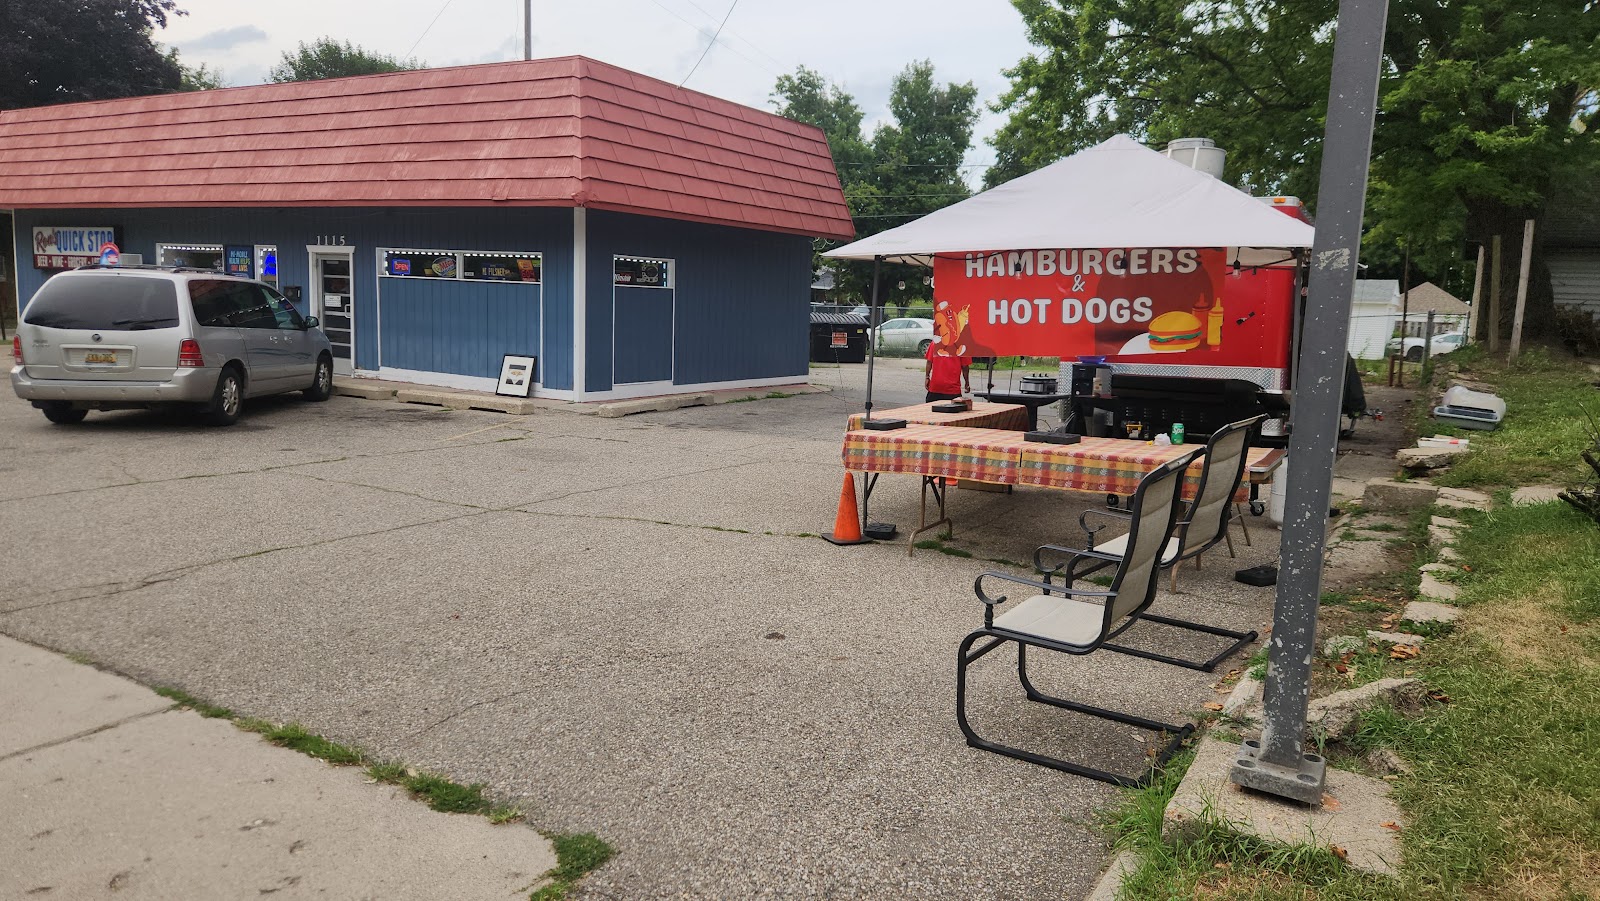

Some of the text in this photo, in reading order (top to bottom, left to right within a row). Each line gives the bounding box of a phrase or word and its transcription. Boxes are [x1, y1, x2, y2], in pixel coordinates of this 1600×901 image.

[57, 230, 85, 253] QUICK
[317, 235, 345, 246] 1115
[37, 255, 48, 267] BEER
[52, 256, 64, 267] WINE
[395, 262, 409, 271] OPEN
[965, 248, 1198, 278] HAMBURGERS
[1072, 274, 1086, 292] &
[988, 297, 1153, 324] HOT DOGS
